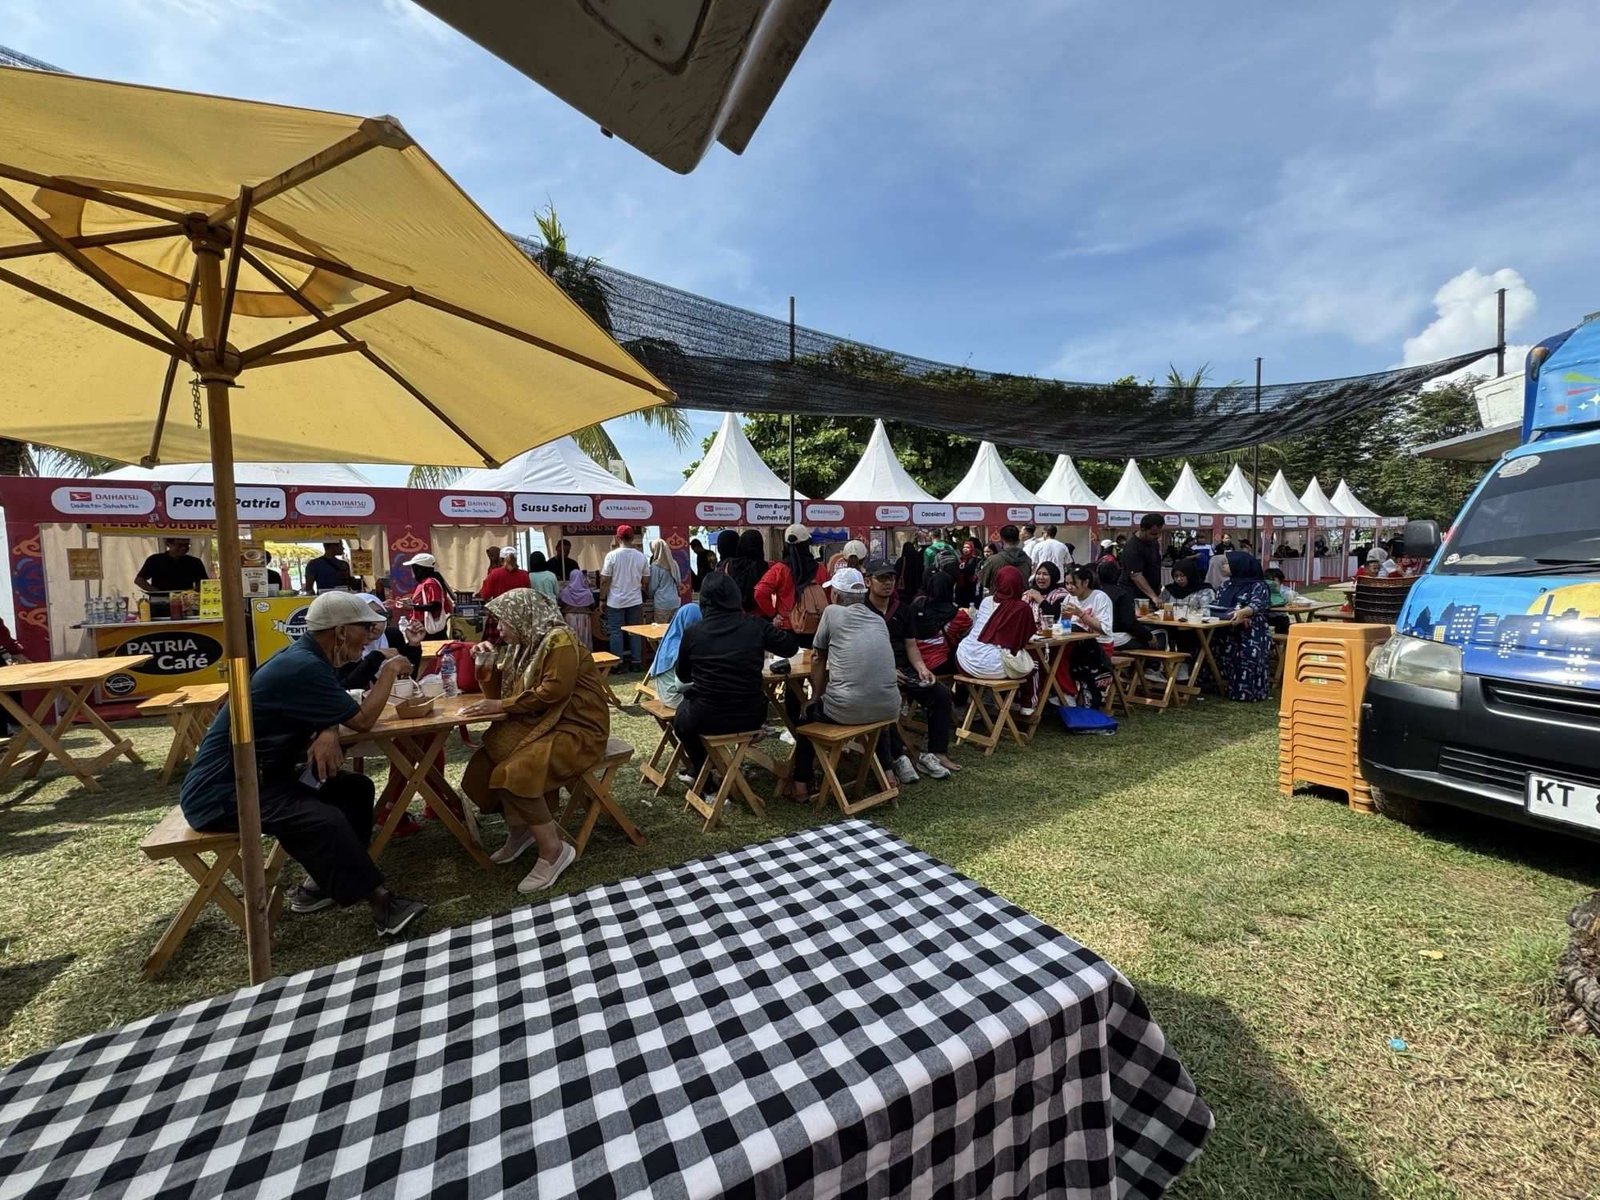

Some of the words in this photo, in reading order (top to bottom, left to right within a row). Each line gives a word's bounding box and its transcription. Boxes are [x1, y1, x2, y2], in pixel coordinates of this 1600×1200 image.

[172, 497, 216, 507] Pent
[521, 503, 549, 512] Susu
[551, 503, 587, 513] Sehati
[773, 503, 790, 511] Burg
[126, 638, 198, 655] PATRIA
[157, 653, 209, 670] Café
[1535, 779, 1576, 808] KT
